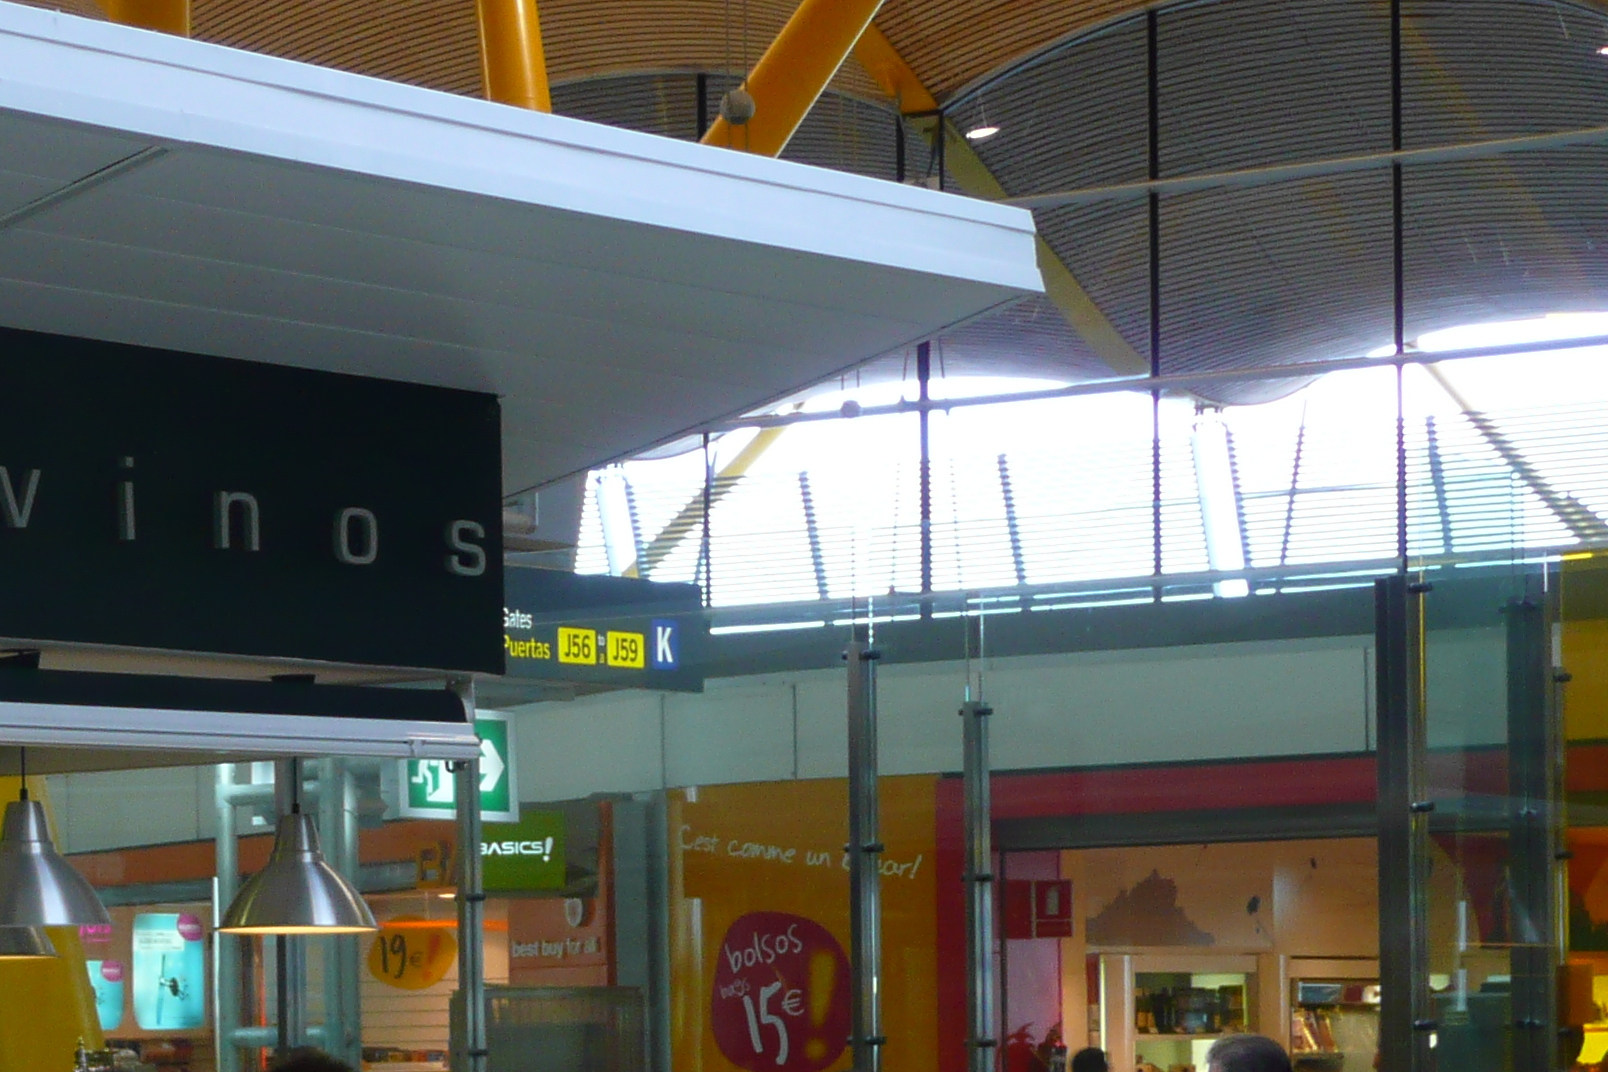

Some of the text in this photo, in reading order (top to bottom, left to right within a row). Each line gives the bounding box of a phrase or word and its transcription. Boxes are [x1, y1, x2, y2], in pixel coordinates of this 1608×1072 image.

[564, 633, 591, 659] J56
[612, 637, 639, 662] J59
[656, 625, 674, 663] K
[726, 840, 797, 863] comme
[805, 851, 831, 868] un
[724, 924, 803, 974] bolsos
